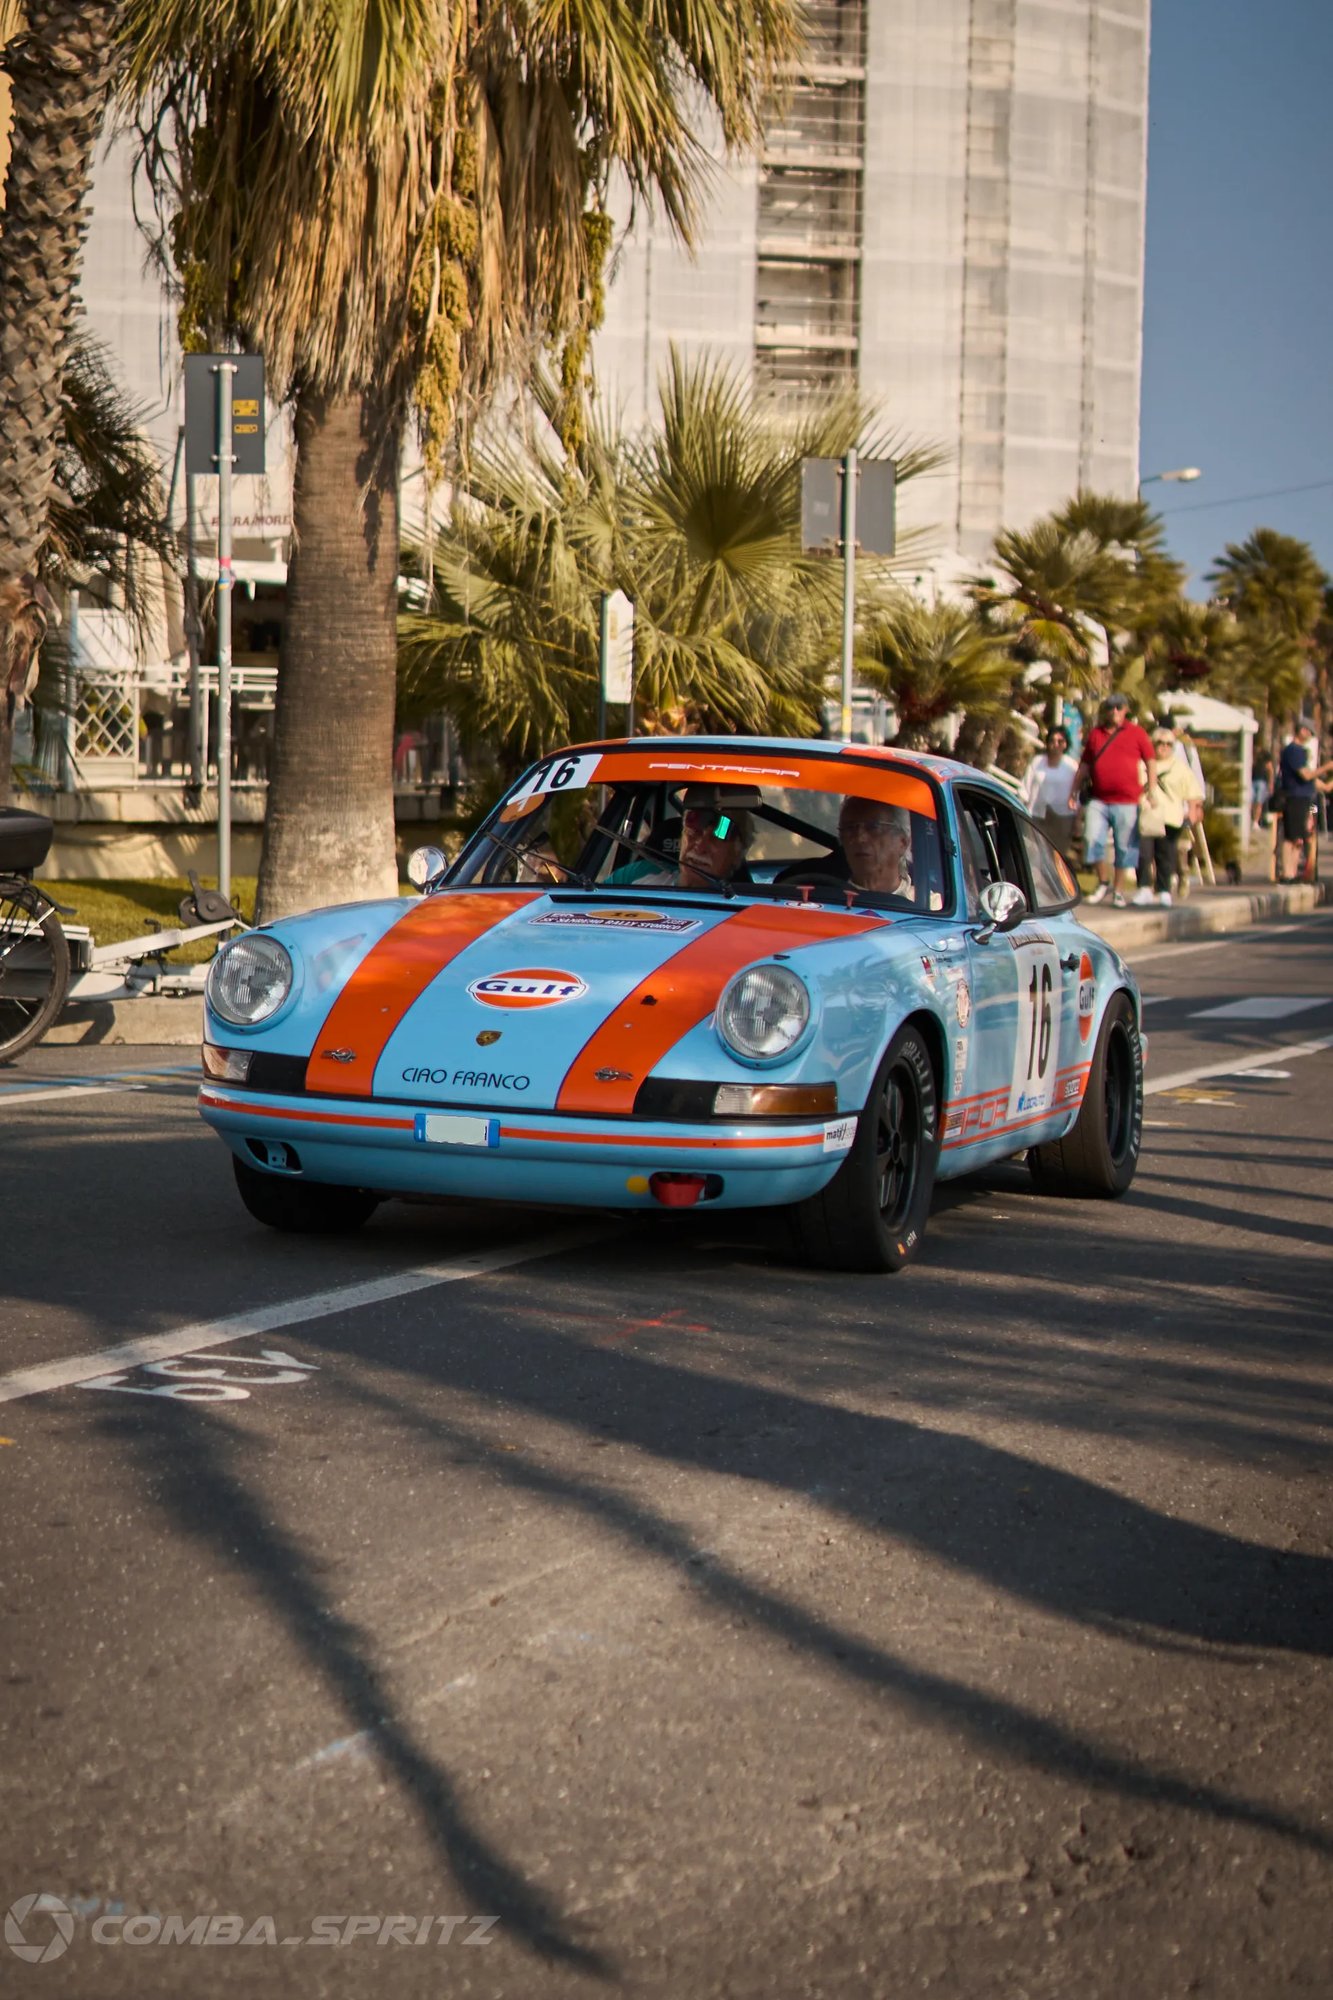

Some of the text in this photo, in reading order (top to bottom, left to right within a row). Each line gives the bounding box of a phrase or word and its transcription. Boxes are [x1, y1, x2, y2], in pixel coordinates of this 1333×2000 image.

[532, 757, 581, 793] 16
[648, 763, 800, 777] PENTACAR
[476, 980, 580, 996] Gulf
[1079, 985, 1095, 1010] Gulf
[1027, 963, 1052, 1080] 16
[402, 1068, 530, 1091] CIAO FRANCO
